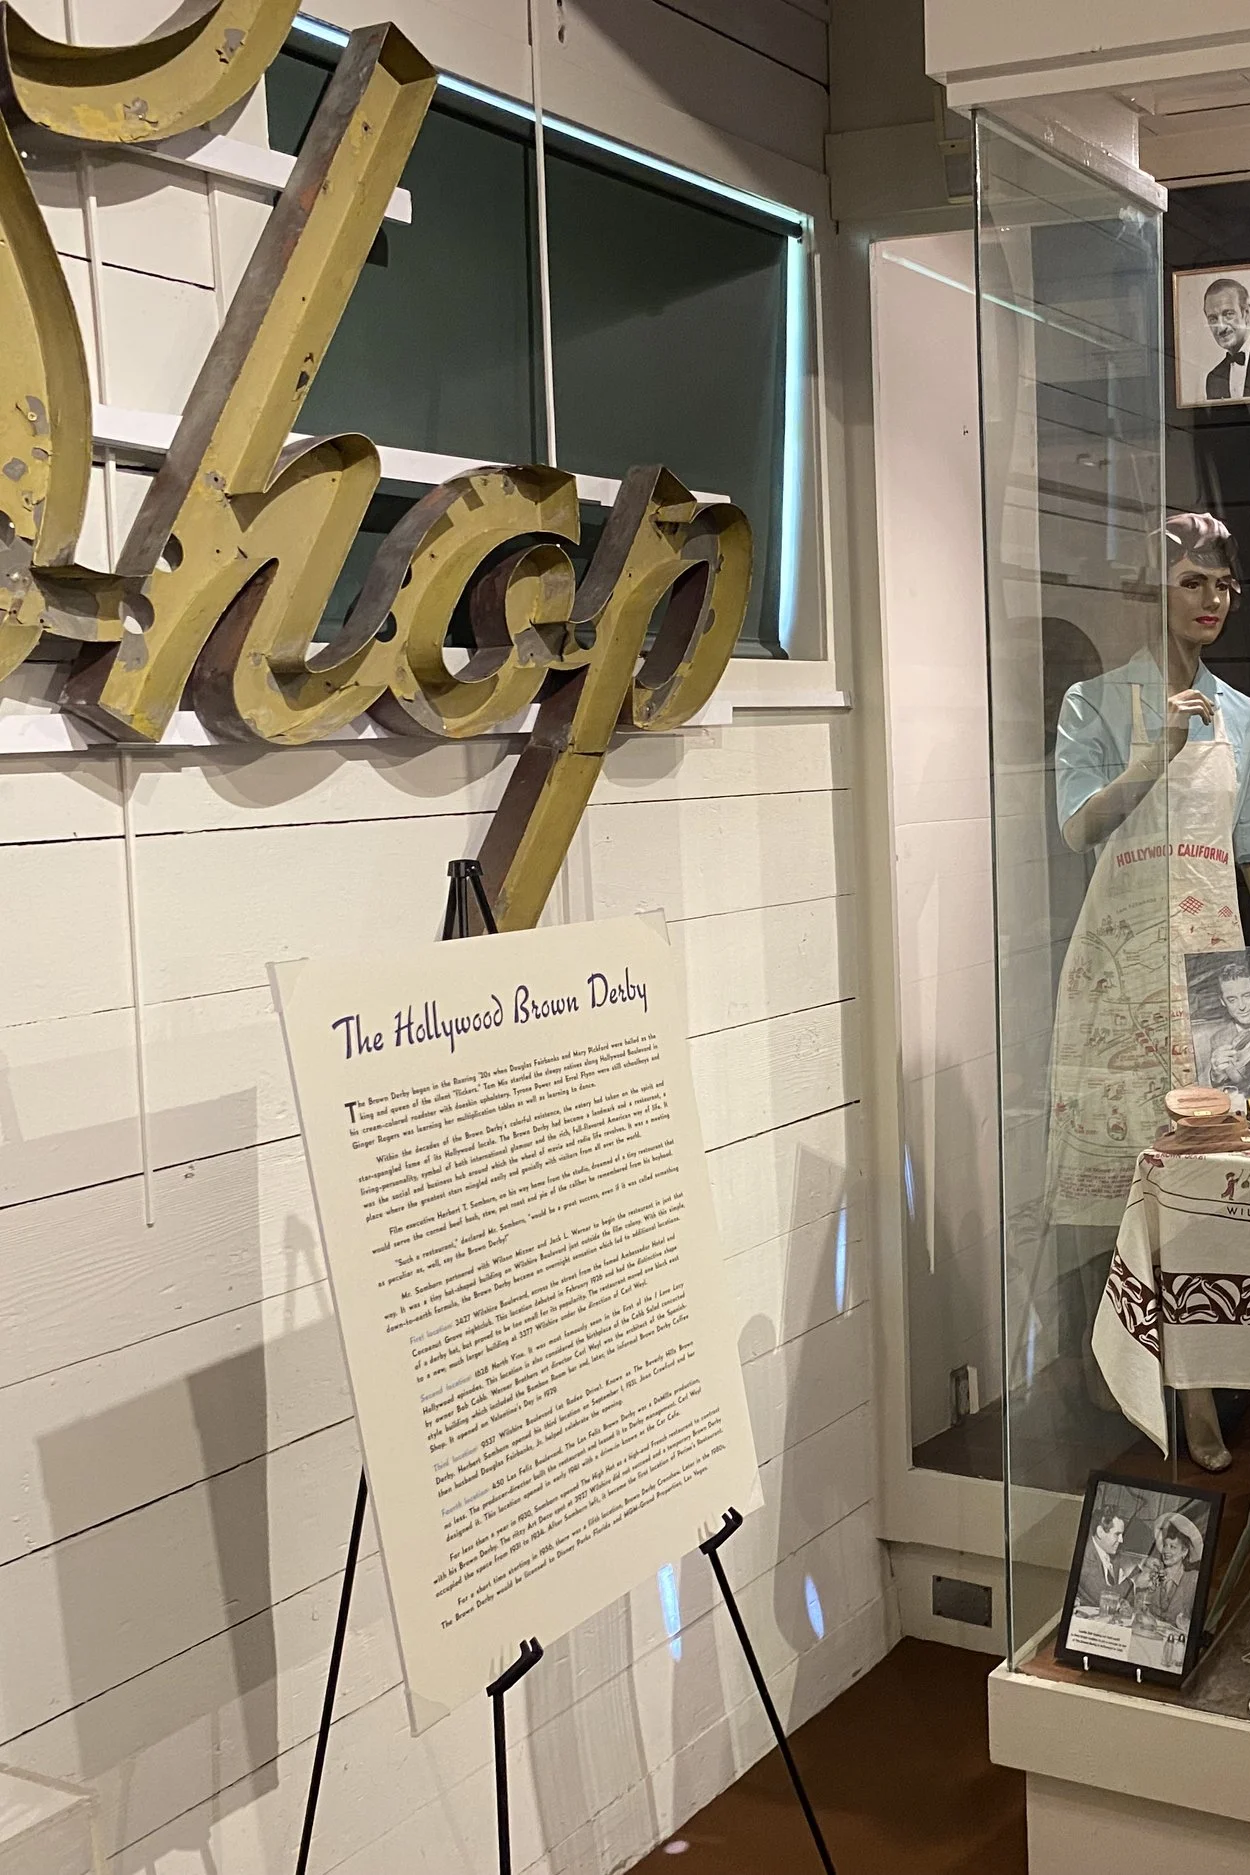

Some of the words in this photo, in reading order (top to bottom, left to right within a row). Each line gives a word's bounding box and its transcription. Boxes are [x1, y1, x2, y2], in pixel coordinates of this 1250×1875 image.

[1177, 843, 1230, 865] CALIFORNIA
[331, 1013, 384, 1059] The
[393, 993, 503, 1054] Hollywood
[513, 984, 579, 1024] Brown
[586, 966, 647, 1013] Derby
[359, 1112, 374, 1120] king
[389, 1103, 410, 1114] queen
[433, 1092, 451, 1102] silent
[510, 1071, 532, 1084] startled
[544, 1067, 561, 1075] sleepy
[563, 1062, 582, 1070] natives
[583, 1058, 598, 1066] along
[599, 1049, 625, 1062] Hollywood
[626, 1043, 651, 1055] Boulevard
[367, 1096, 388, 1105] Brown
[390, 1088, 409, 1100] Derby
[410, 1086, 430, 1095] began
[452, 1075, 476, 1085] Roaring
[492, 1067, 508, 1075] when
[508, 1061, 532, 1072] Douglas
[533, 1054, 559, 1066] Fairbanks
[587, 1042, 609, 1054] Pickford
[623, 1035, 639, 1045] hailed
[410, 1110, 436, 1120] roadster
[438, 1104, 452, 1113] with
[512, 1086, 532, 1096] Tyrone
[533, 1081, 551, 1090] Power
[579, 1070, 595, 1078] Flynn
[611, 1061, 621, 1071] still
[351, 1139, 375, 1150] Ginger
[376, 1133, 400, 1143] Rogers
[415, 1121, 442, 1132] learning
[497, 1102, 515, 1111] tables
[525, 1094, 536, 1104] well
[546, 1088, 569, 1098] learning
